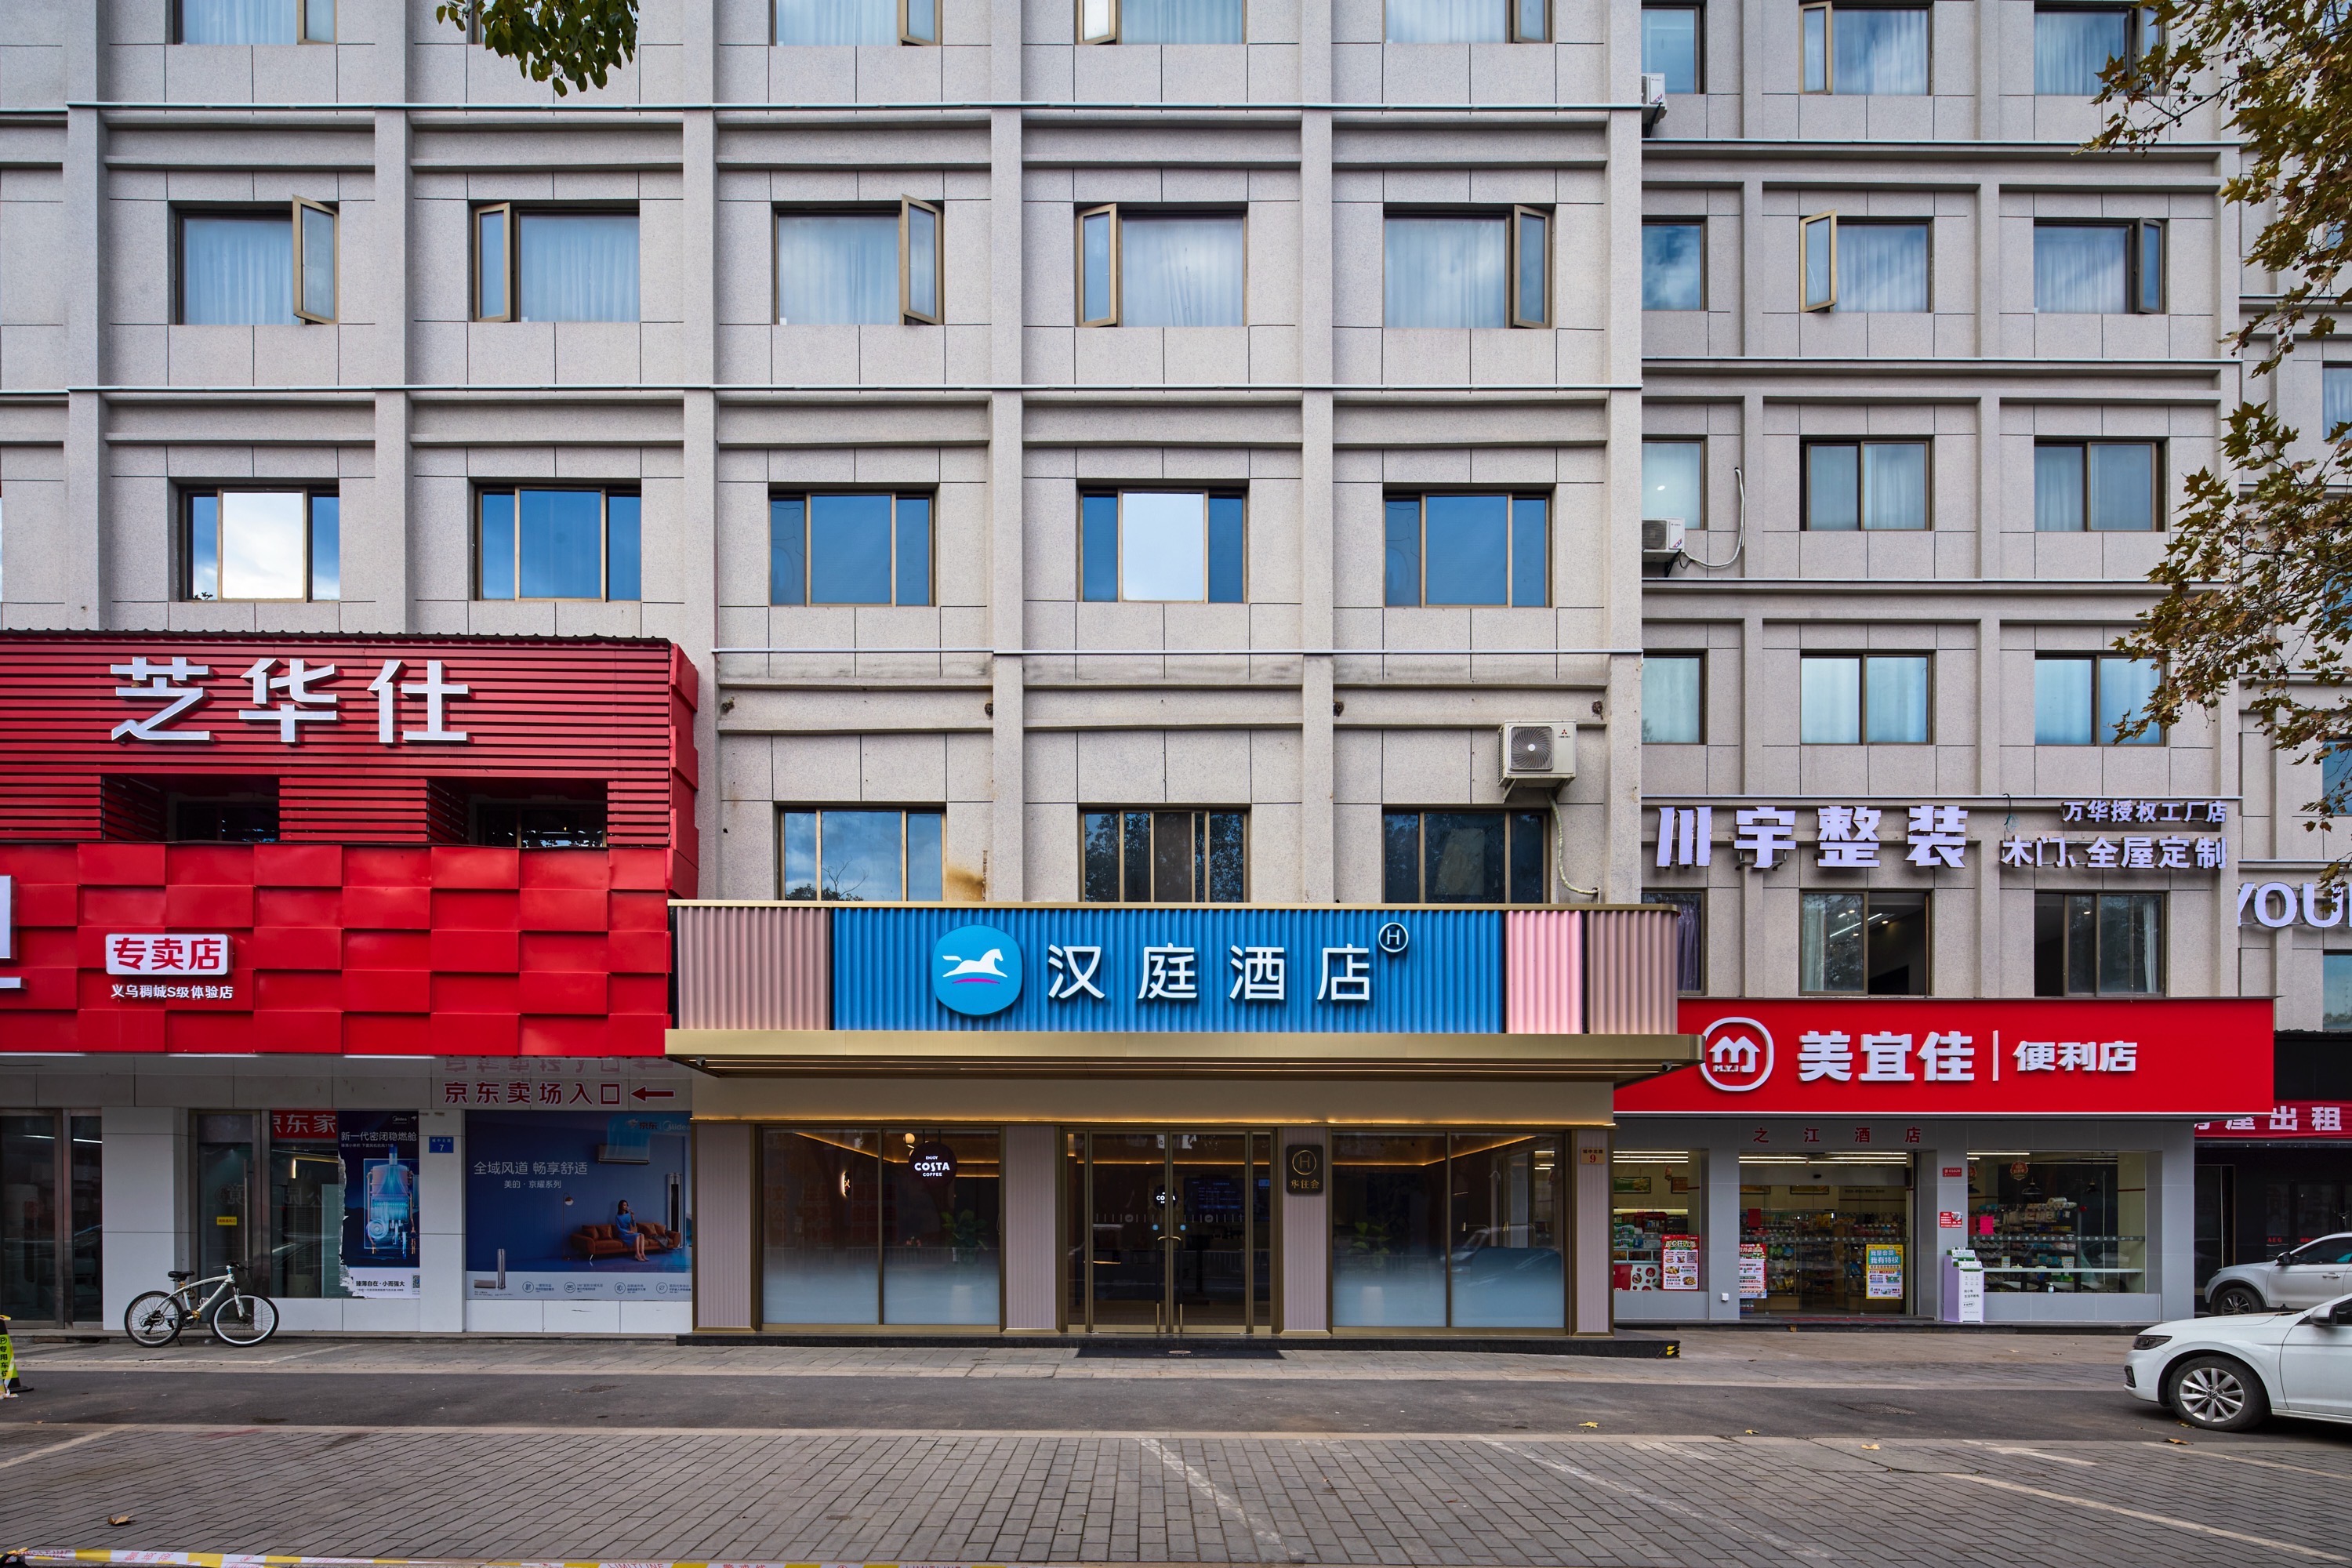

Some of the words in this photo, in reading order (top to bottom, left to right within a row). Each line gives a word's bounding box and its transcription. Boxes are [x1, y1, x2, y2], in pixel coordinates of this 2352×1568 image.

[110, 656, 470, 743] 芝华仕
[2063, 800, 2227, 822] 万华授权工厂店
[1656, 806, 1969, 868] 川宇整装
[2001, 835, 2227, 869] 木门、全屋定制
[2238, 882, 2352, 927] YOU
[113, 937, 221, 971] 专卖店
[1048, 942, 1370, 1000] 汉庭酒店
[111, 984, 234, 1000] 义乌稠城S级体验店
[1797, 1030, 1975, 1082] 美宜佳
[2013, 1040, 2138, 1072] 便利店
[444, 1081, 622, 1105] 京东卖场入口
[1752, 1127, 1922, 1144] 之江酒店
[474, 1161, 528, 1175] 全域风道
[532, 1161, 588, 1175] 畅享舒适
[914, 1162, 950, 1172] COSTA
[1590, 1154, 1596, 1163] 9
